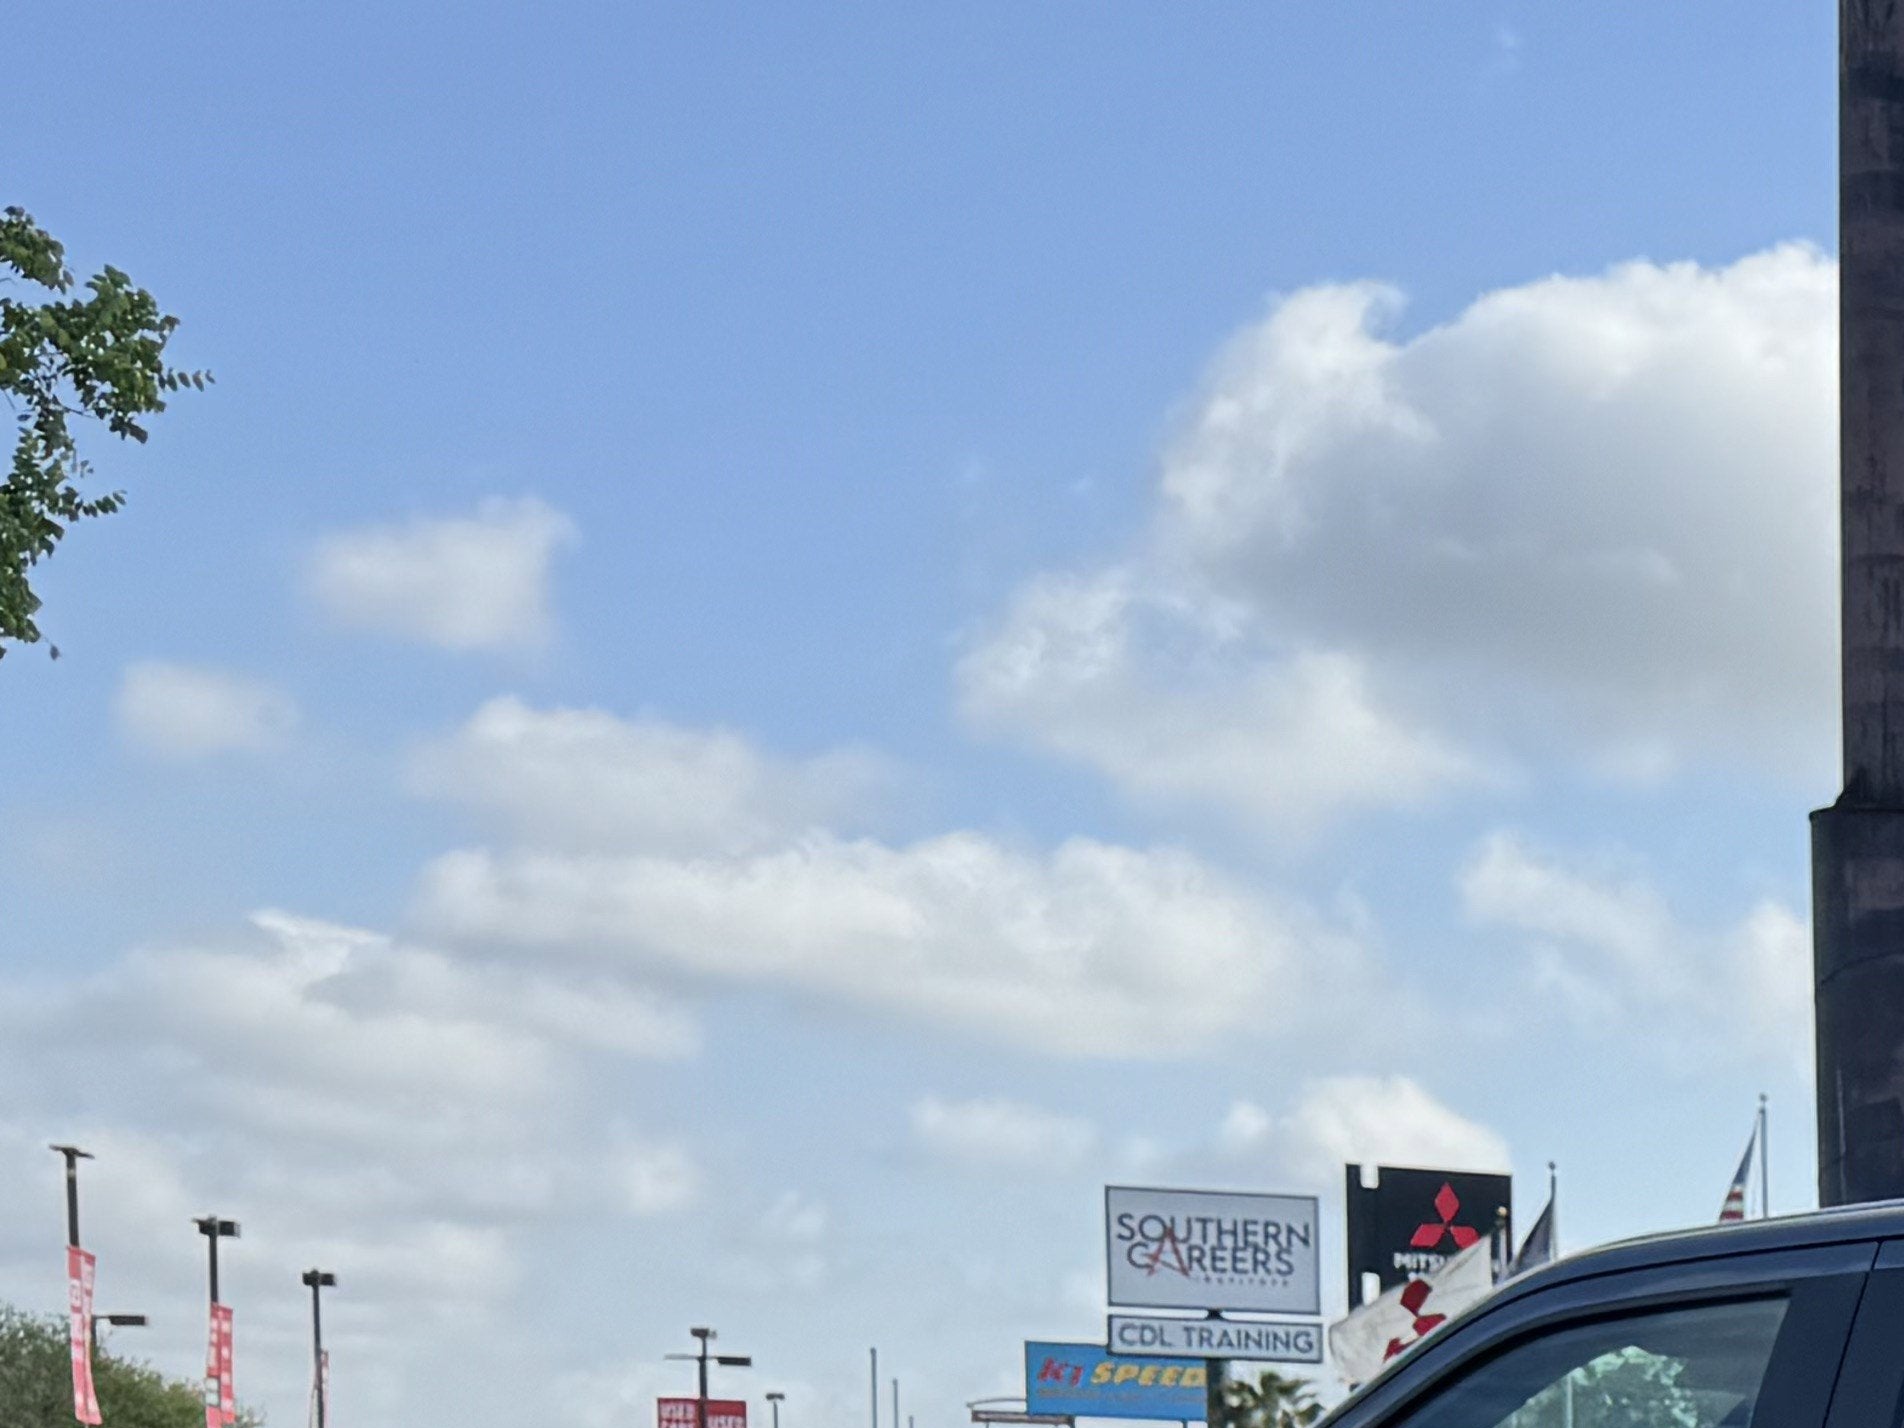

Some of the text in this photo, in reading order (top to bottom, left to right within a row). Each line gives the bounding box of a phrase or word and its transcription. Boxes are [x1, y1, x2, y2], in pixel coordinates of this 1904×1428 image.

[1116, 1213, 1311, 1248] SOUTHERN
[1126, 1230, 1295, 1277] CAREERS
[1118, 1323, 1314, 1354] CDL TRAINING
[1090, 1361, 1208, 1388] SPEED
